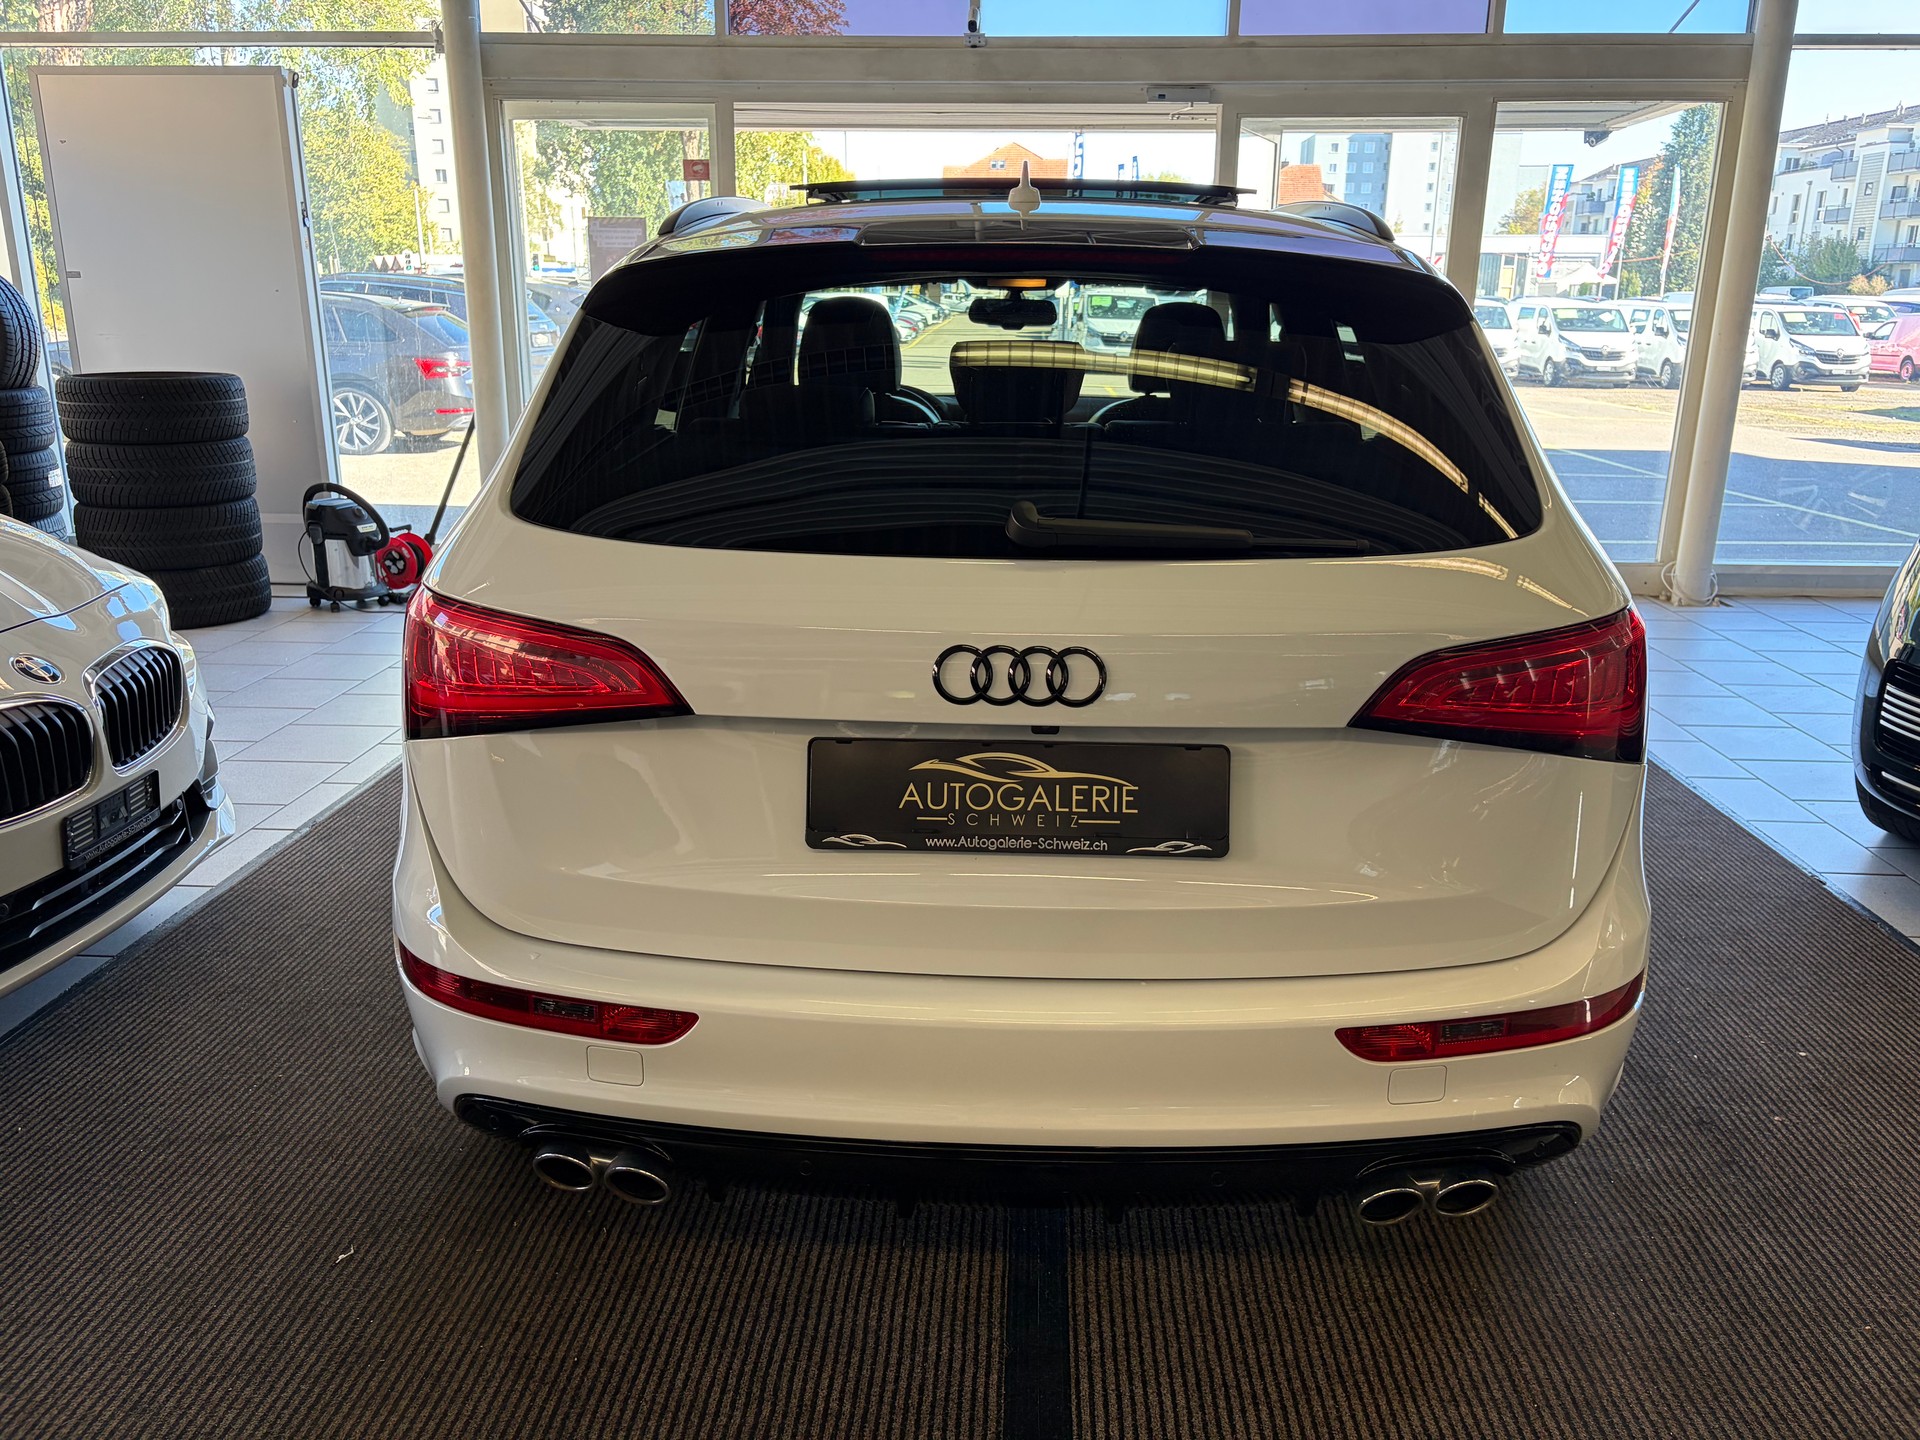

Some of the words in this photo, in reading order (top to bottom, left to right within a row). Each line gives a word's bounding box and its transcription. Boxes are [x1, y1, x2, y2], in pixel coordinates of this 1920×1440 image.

[1538, 165, 1570, 275] OCCASIONEN
[899, 782, 1139, 814] AUTOGALERIE
[947, 813, 1079, 828] SCHWEIZ
[924, 836, 1109, 851] www.Autogalerie-Schweiz.ch
